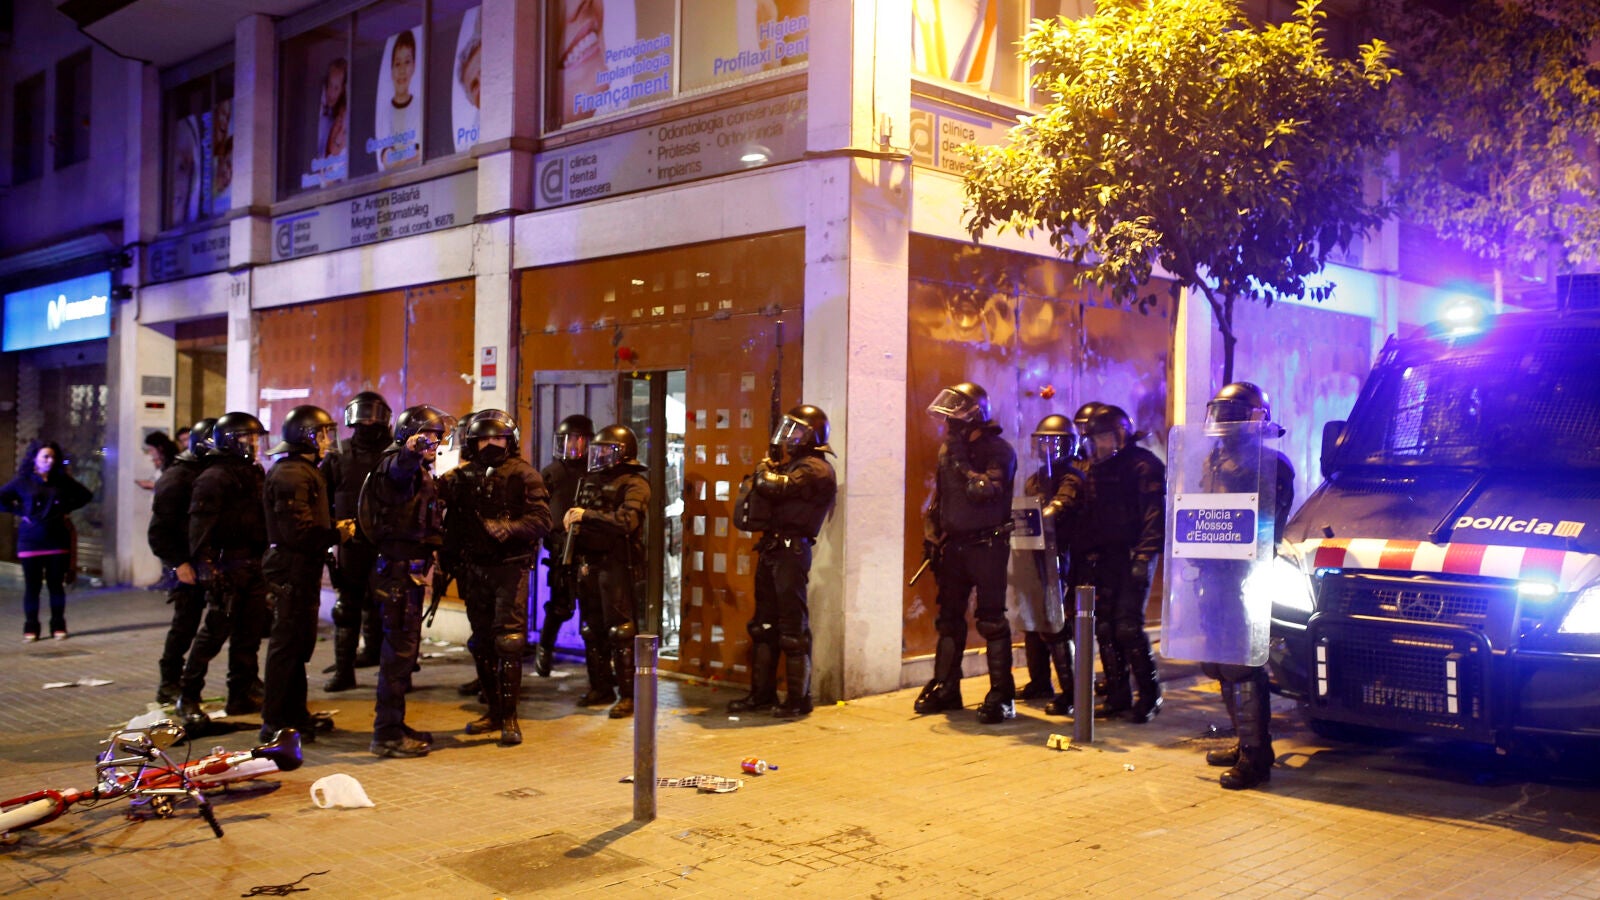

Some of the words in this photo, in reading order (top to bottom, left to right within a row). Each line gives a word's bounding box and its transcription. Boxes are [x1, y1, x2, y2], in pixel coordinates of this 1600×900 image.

[596, 53, 670, 84] Implantologia
[713, 45, 771, 76] Profilaxi
[574, 71, 669, 114] Finançament
[658, 115, 723, 143] Odontologia
[569, 167, 597, 184] dental
[657, 160, 702, 181] Implants
[352, 201, 363, 214] Dr.
[352, 215, 375, 229] Metge
[1195, 520, 1233, 531] Mossos
[1453, 515, 1554, 535] policia
[1186, 530, 1241, 543] d'Esquadra
